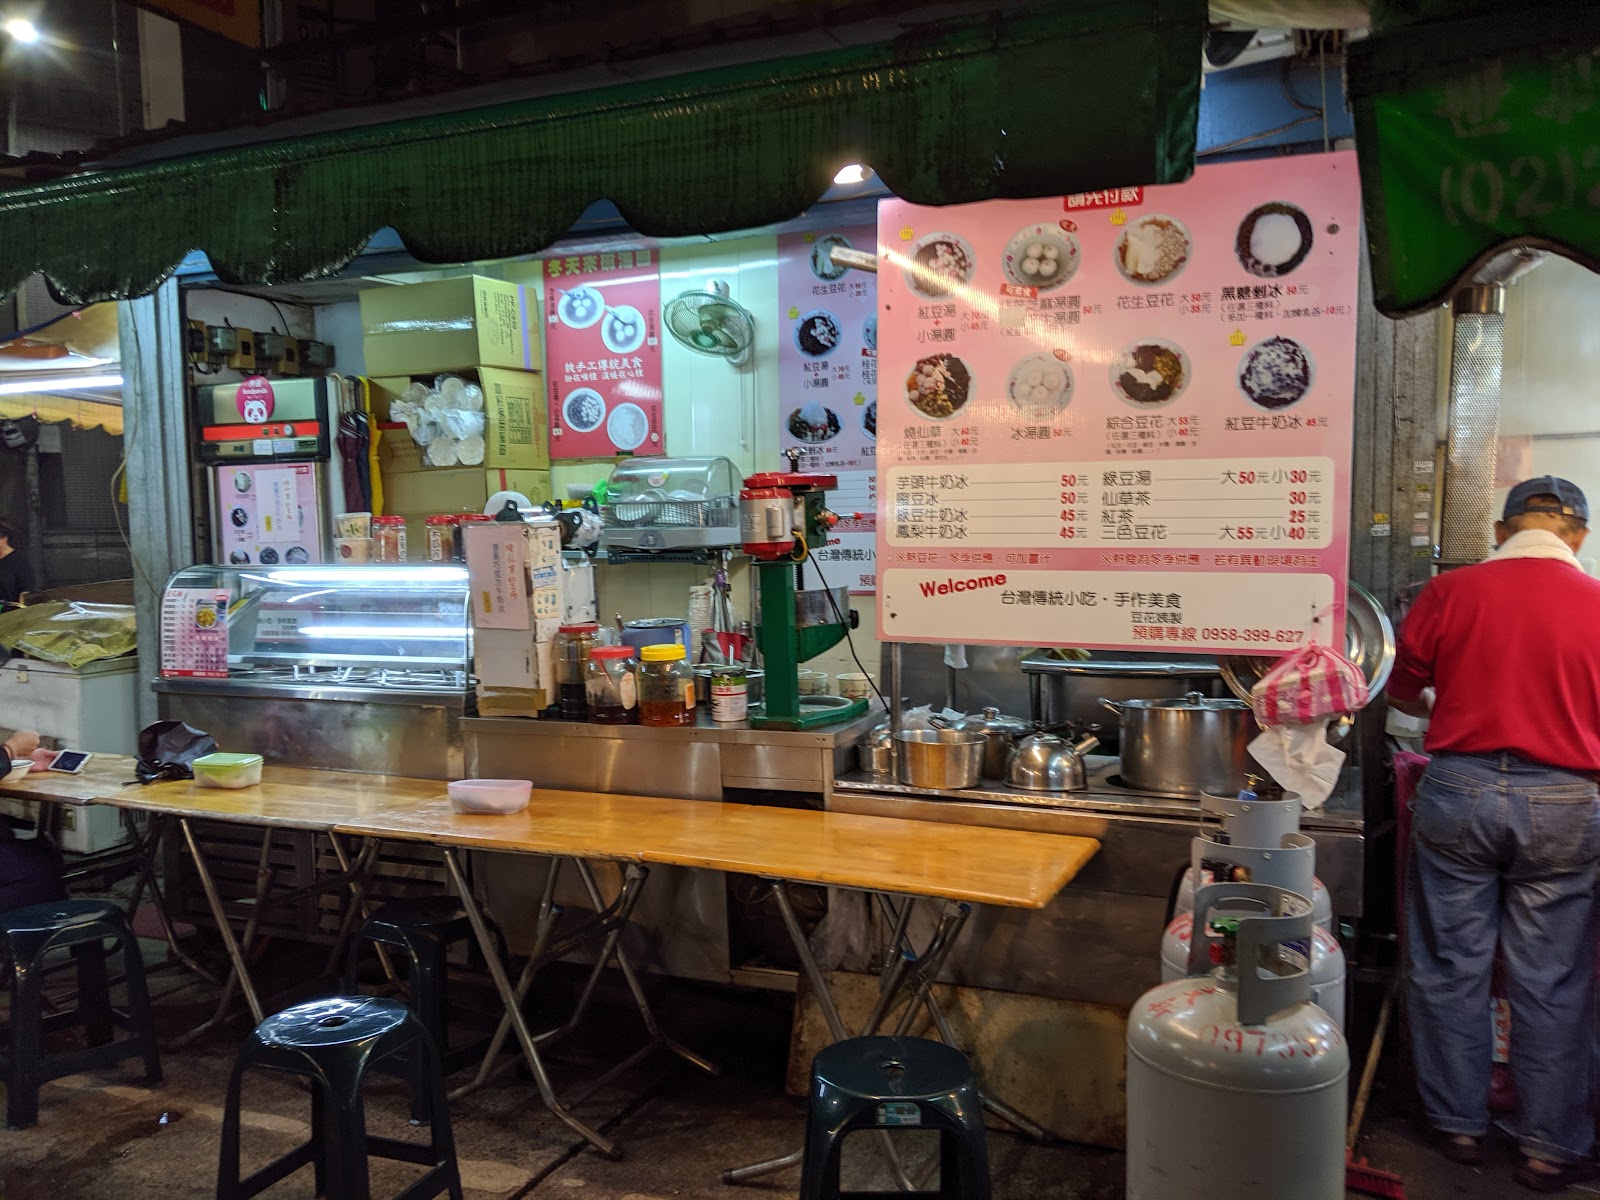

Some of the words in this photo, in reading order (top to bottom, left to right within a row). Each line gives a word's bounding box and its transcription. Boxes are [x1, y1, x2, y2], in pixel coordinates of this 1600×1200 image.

[1117, 292, 1175, 310] 花生豆花
[917, 304, 956, 319] 紅豆湯
[917, 328, 956, 343] 小湯圓
[1106, 415, 1164, 430] 綜合豆花
[1224, 415, 1303, 431] 紅豆牛奶冰
[903, 424, 943, 440] 燒仙草
[1010, 426, 1051, 440] 冰湯圓
[896, 474, 970, 489] 芋頭牛奶冰
[1060, 475, 1089, 488] 50元
[1101, 470, 1152, 487] 綠豆湯
[1060, 492, 1089, 505] 50元
[1101, 490, 1152, 506] 仙草茶
[1288, 491, 1322, 505] 30元
[896, 508, 969, 523] 綠豆牛奶冰
[1059, 509, 1089, 522] 45元
[1101, 508, 1134, 524] 紅茶
[1287, 509, 1321, 523] 25元
[896, 524, 969, 539] 鳳梨牛奶冰
[1059, 526, 1088, 539] 45元
[1100, 524, 1168, 540] 三色豆花
[919, 572, 1007, 598] Welcome
[1132, 625, 1197, 641] 預購專線
[1201, 627, 1304, 643] 0958-399-627
